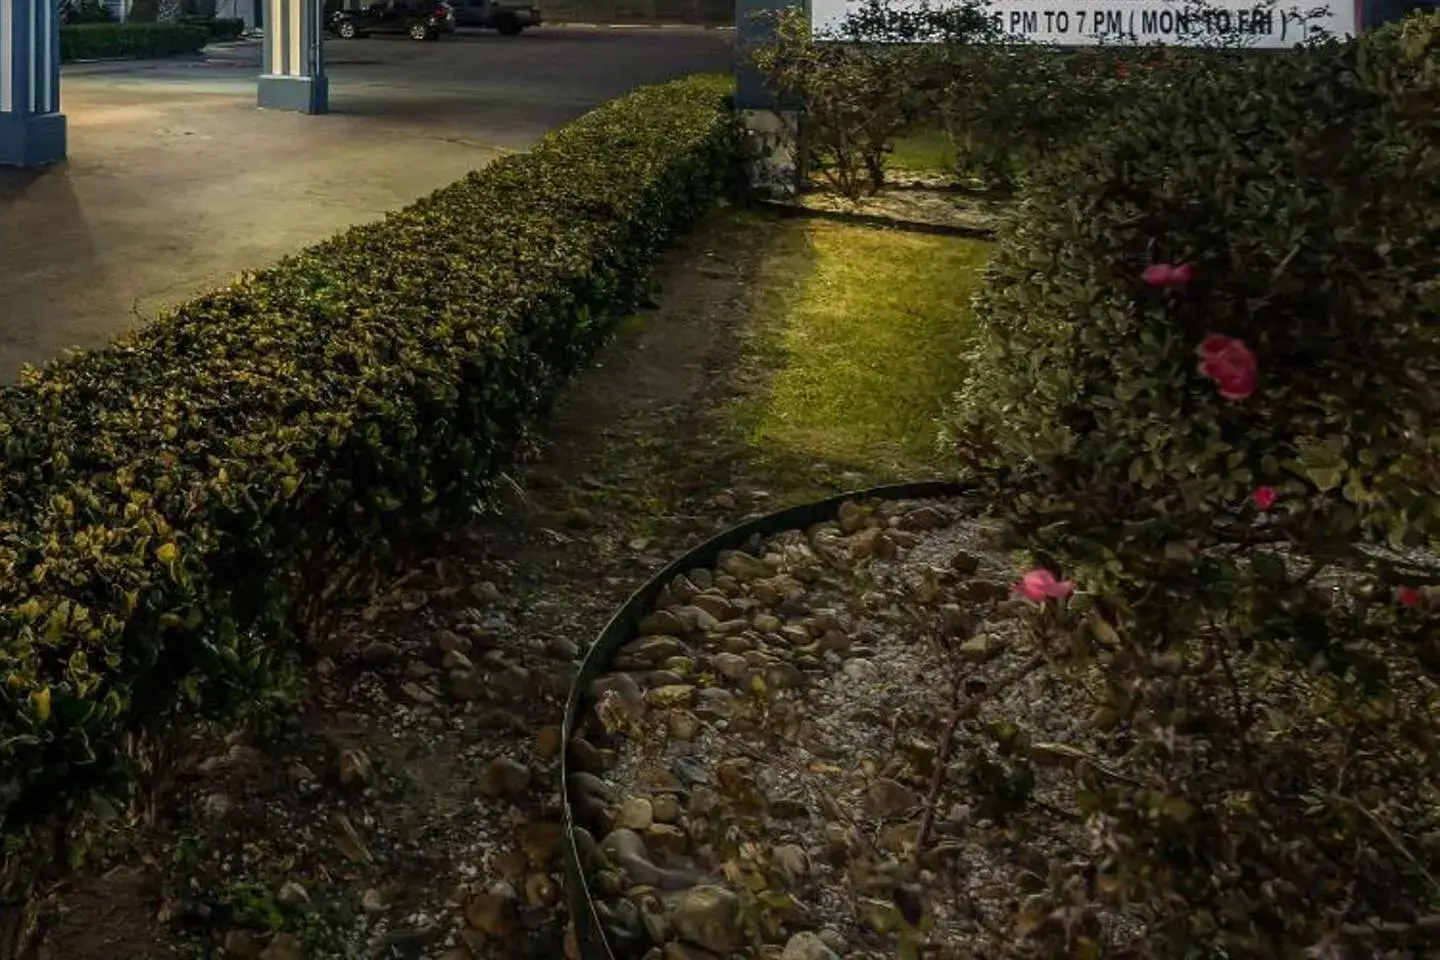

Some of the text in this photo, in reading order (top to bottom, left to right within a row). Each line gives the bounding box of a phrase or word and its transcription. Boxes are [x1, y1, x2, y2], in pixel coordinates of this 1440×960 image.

[1010, 12, 1038, 33] PM
[1044, 11, 1069, 33] TO
[1076, 11, 1086, 33] 7
[1094, 11, 1121, 34] PM
